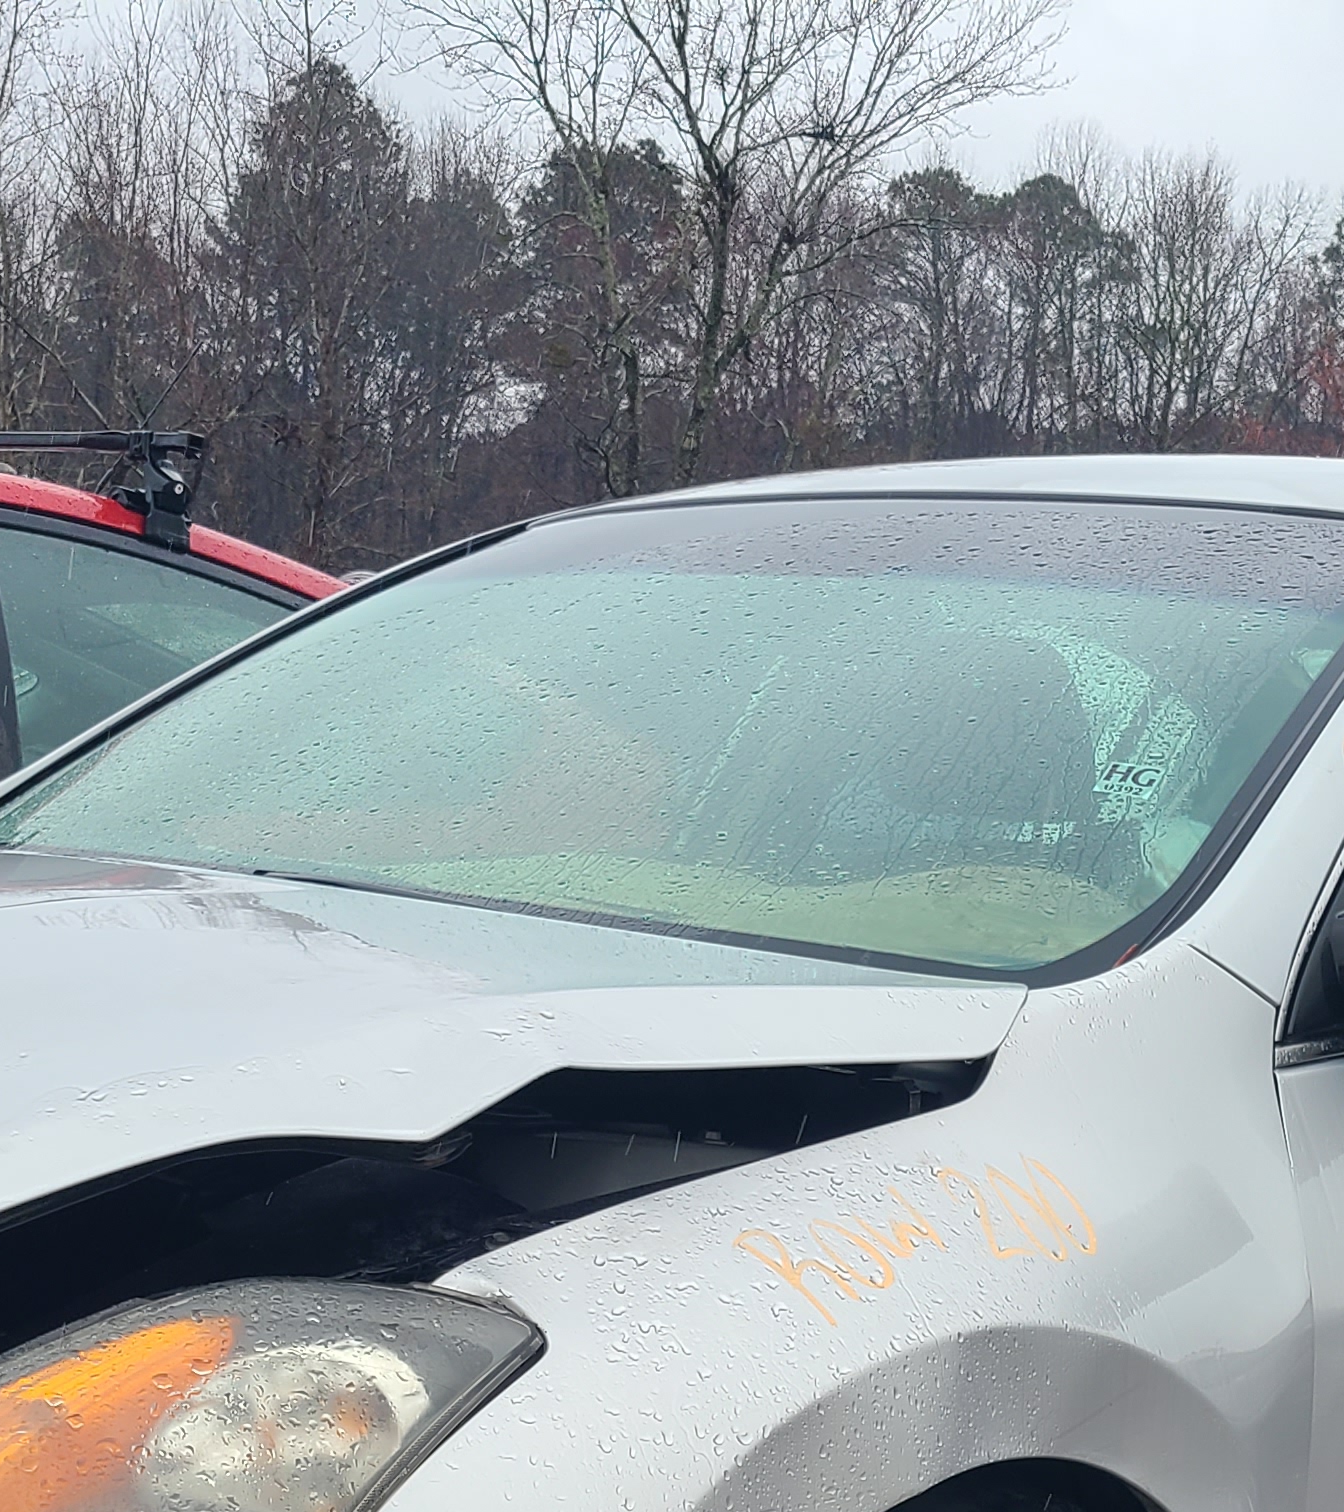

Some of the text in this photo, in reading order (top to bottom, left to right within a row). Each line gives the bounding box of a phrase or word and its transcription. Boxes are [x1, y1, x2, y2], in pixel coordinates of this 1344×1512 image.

[1103, 763, 1161, 787] HG
[1103, 783, 1143, 796] 0392
[936, 1152, 1097, 1262] 200
